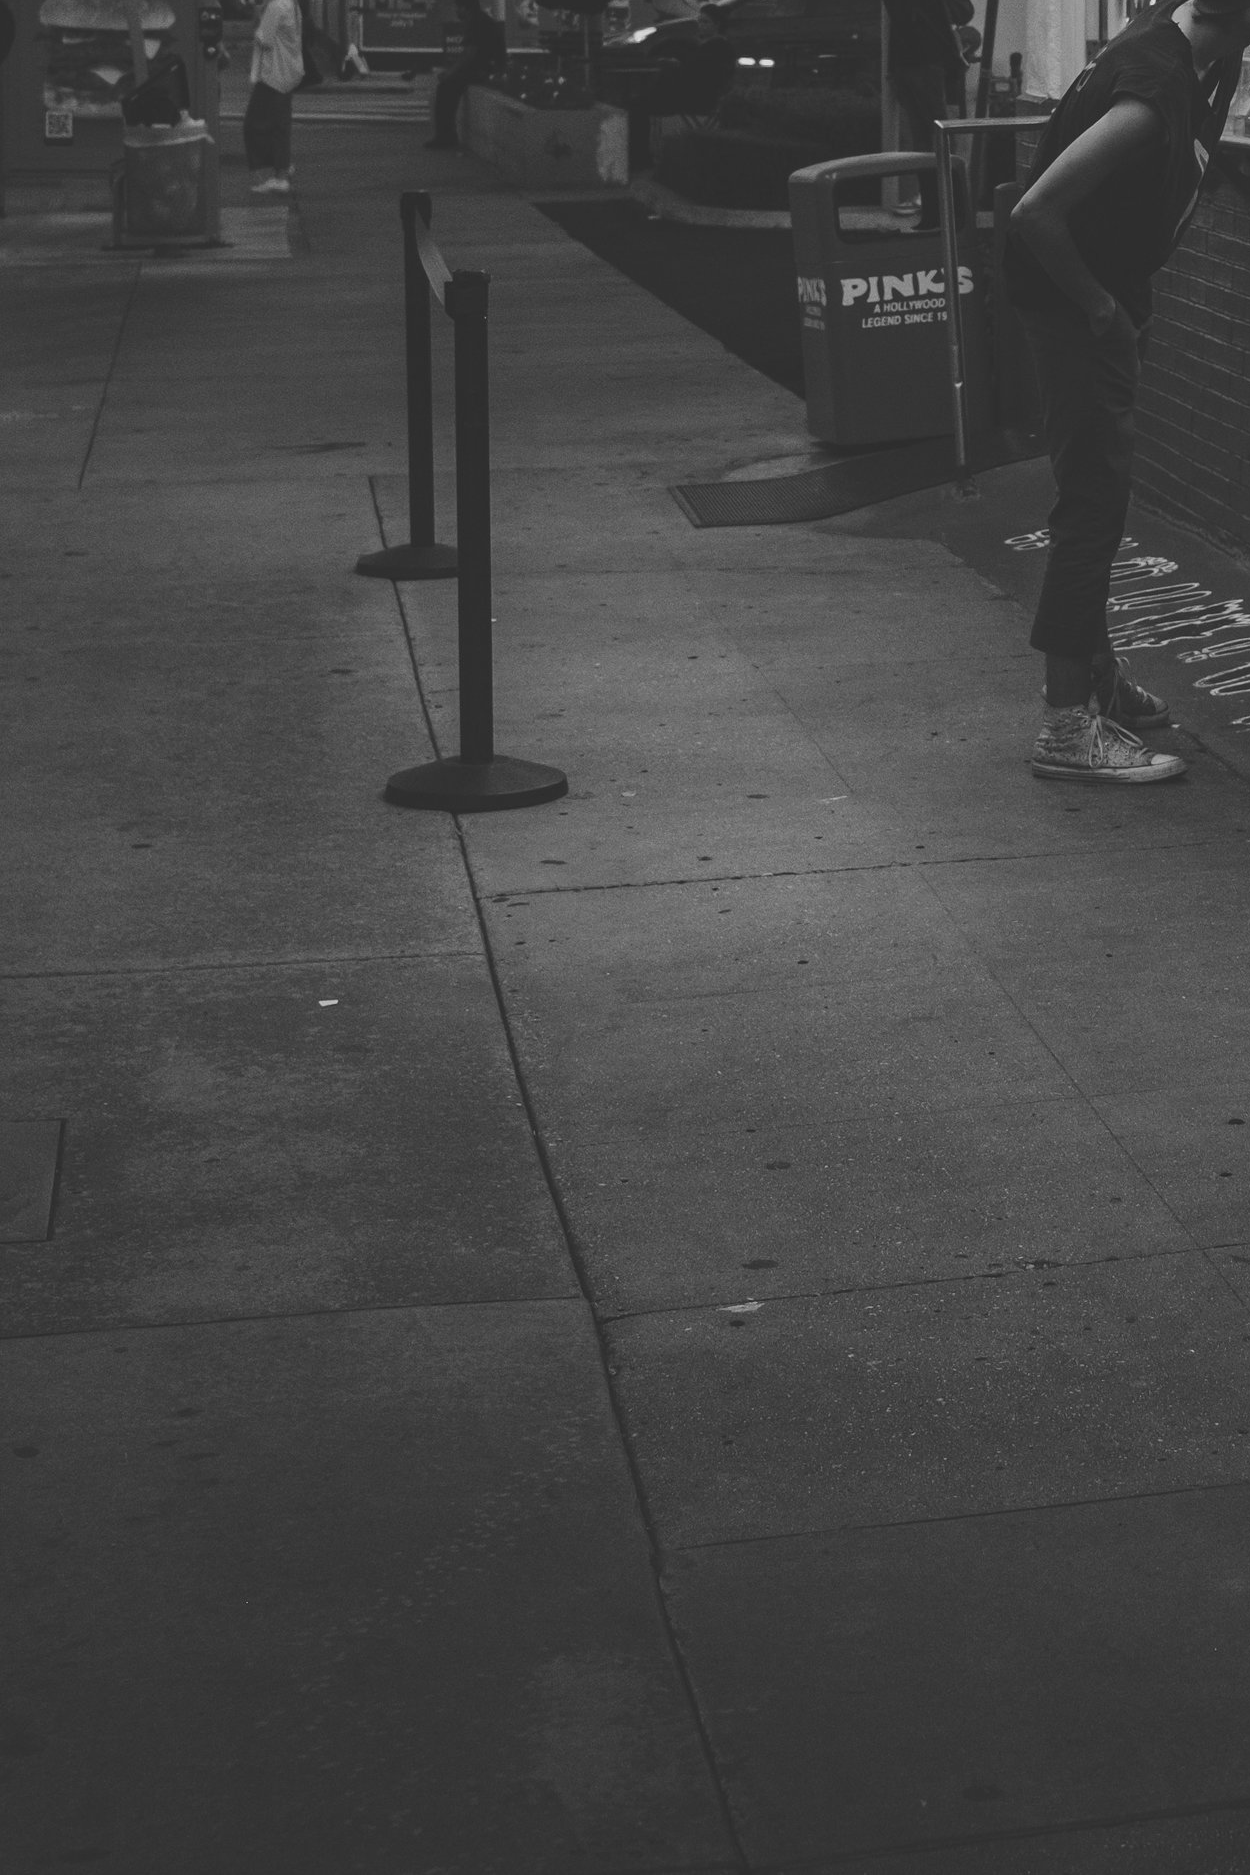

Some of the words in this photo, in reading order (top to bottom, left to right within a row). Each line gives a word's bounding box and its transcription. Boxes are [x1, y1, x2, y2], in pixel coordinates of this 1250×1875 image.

[840, 266, 975, 307] PINK'S
[873, 303, 881, 314] A
[883, 298, 946, 313] HOLLYWOOD
[861, 315, 902, 329] LEGEND
[904, 312, 935, 324] SINCE
